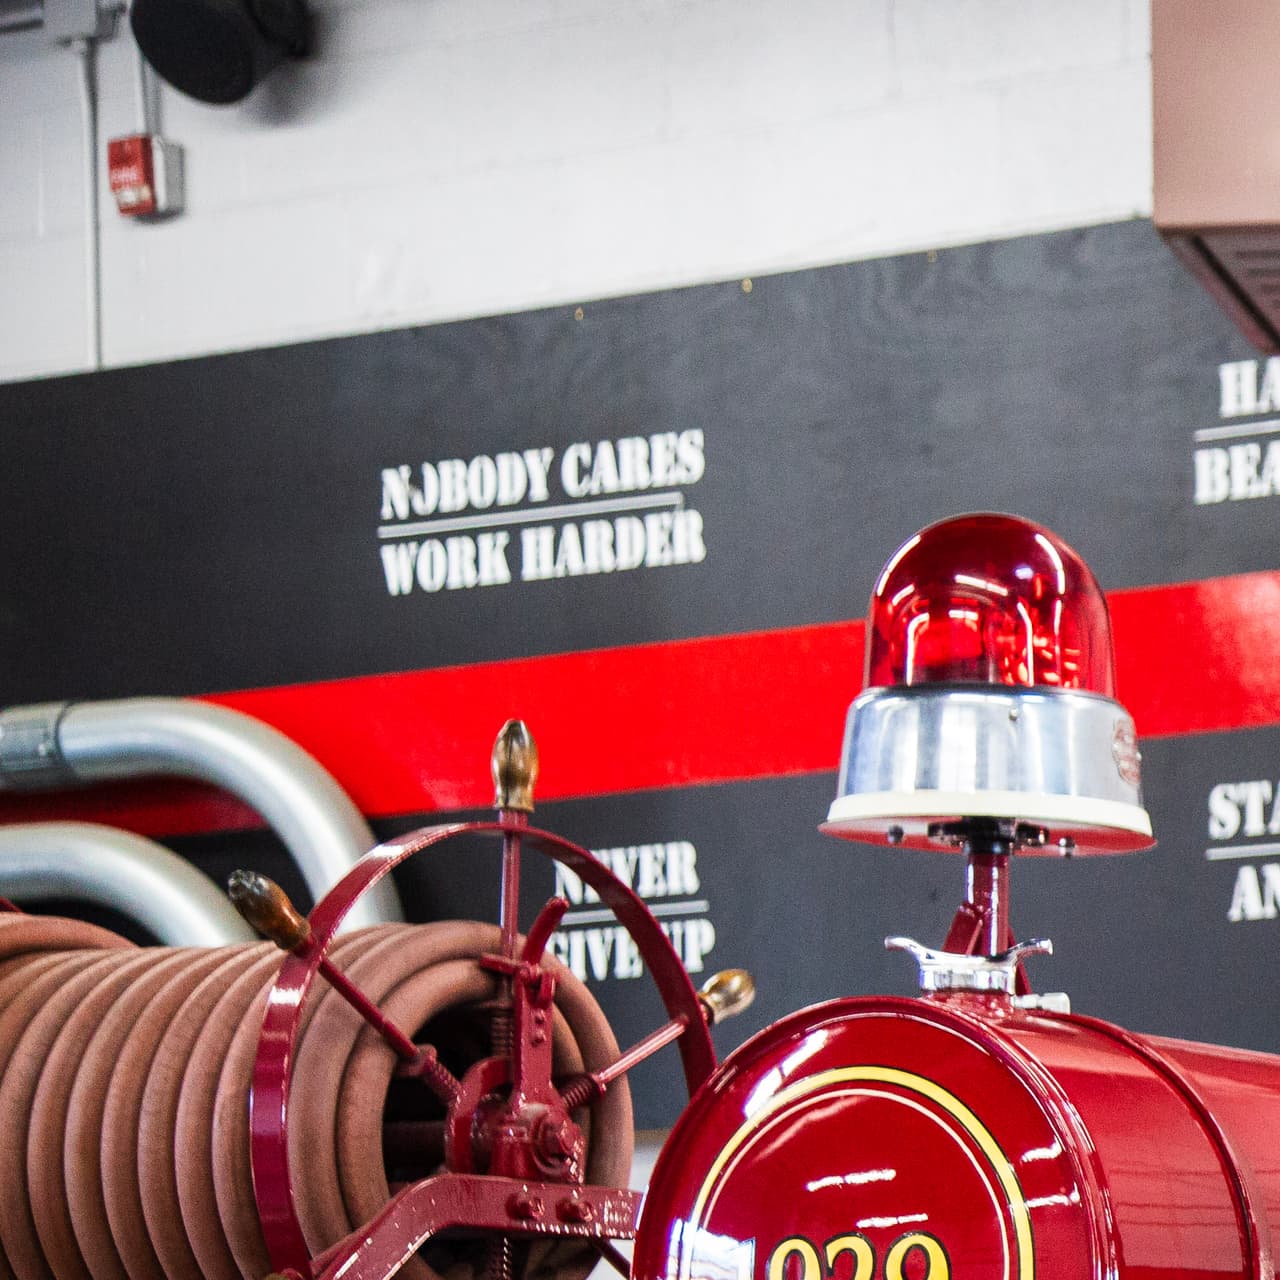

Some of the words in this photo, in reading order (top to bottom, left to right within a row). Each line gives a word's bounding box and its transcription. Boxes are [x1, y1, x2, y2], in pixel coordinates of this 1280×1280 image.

[561, 429, 705, 498] CARES
[380, 531, 511, 596] WORK
[521, 509, 706, 581] HARDER
